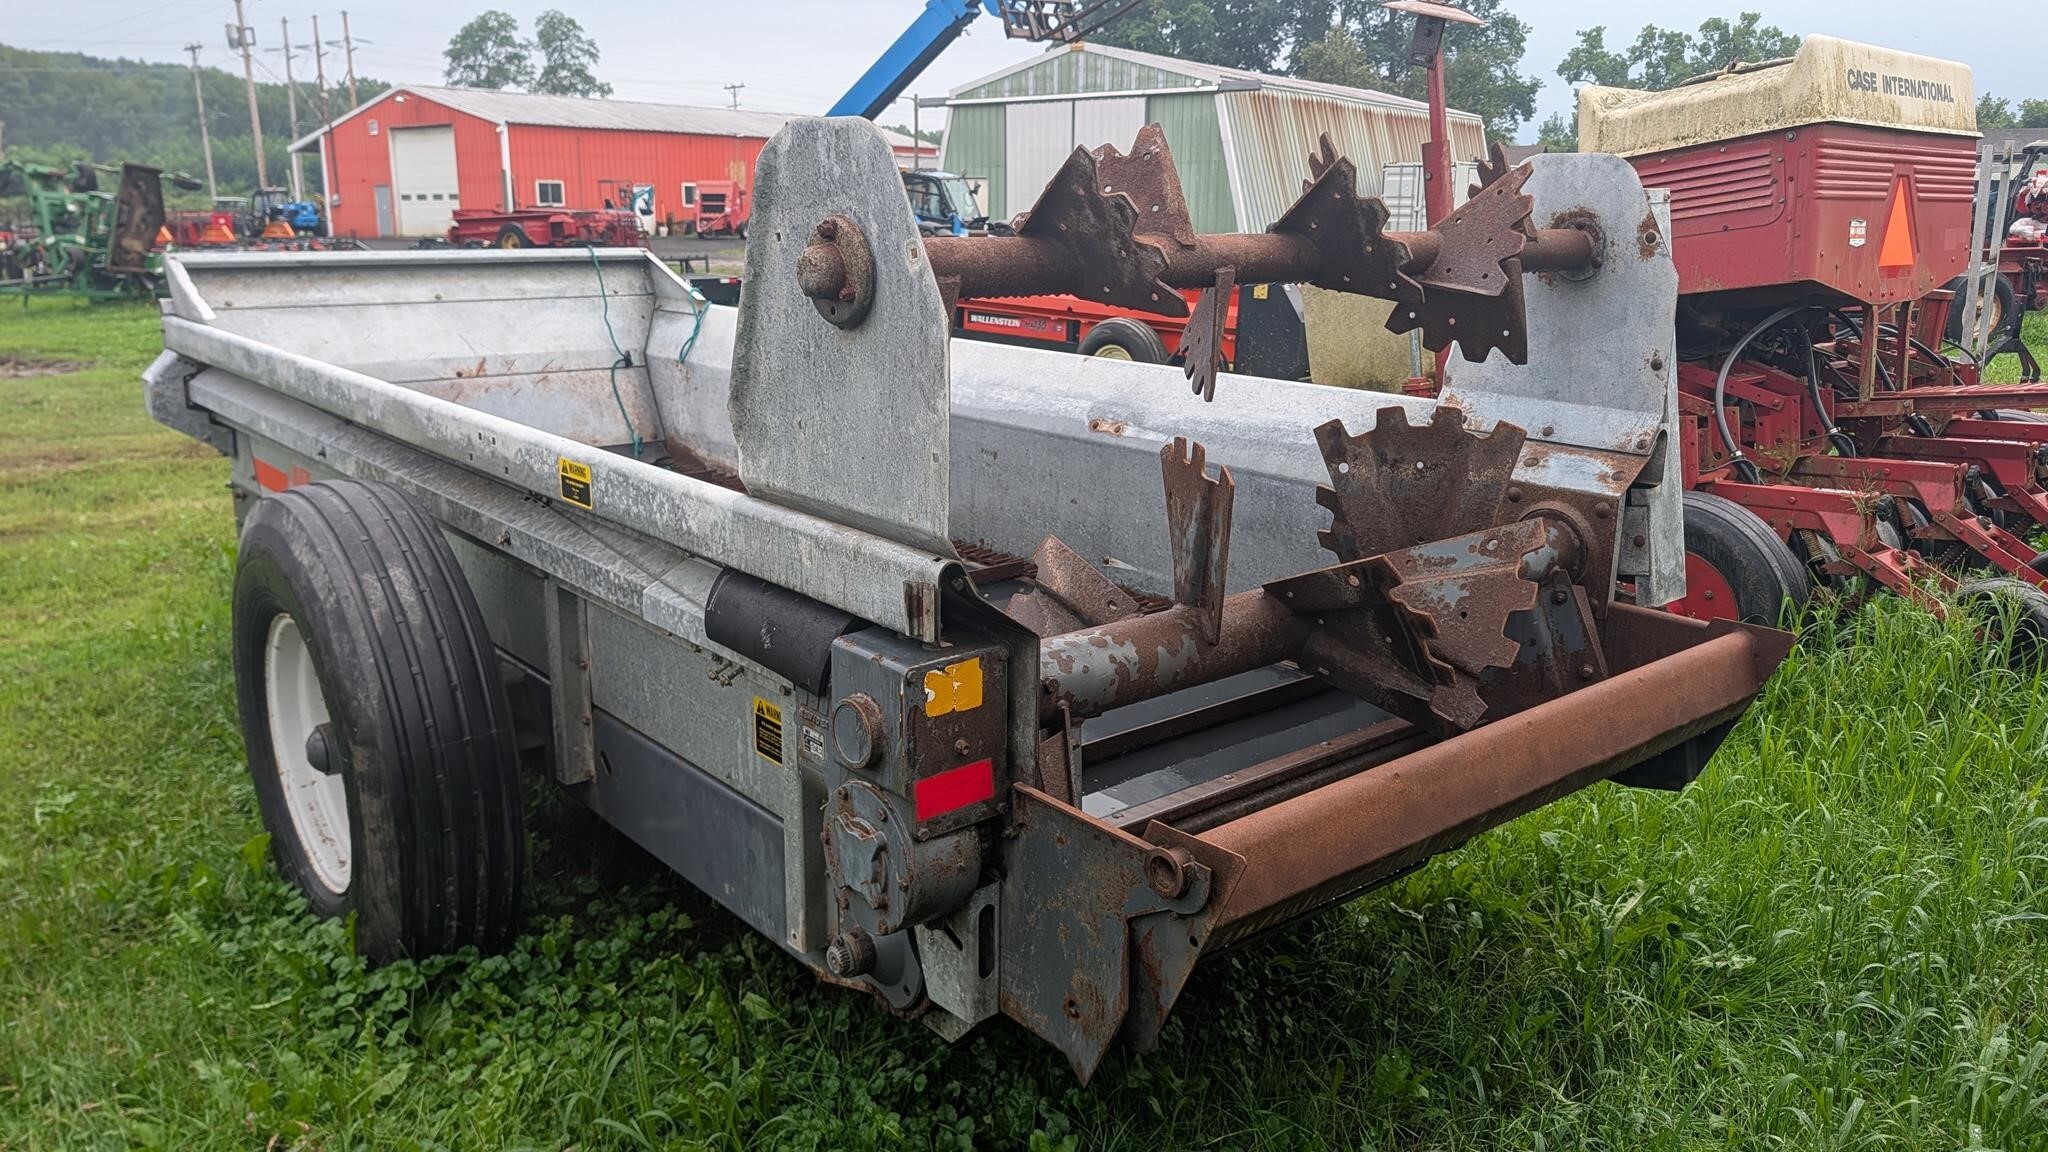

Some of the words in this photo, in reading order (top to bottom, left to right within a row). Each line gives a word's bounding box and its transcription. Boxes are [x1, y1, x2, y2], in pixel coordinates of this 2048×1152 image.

[1847, 68, 1878, 92] CASE
[1882, 74, 1954, 102] INTERNATIONAL
[970, 314, 1020, 328] WALLENSTEIN
[765, 704, 781, 722] WARN
